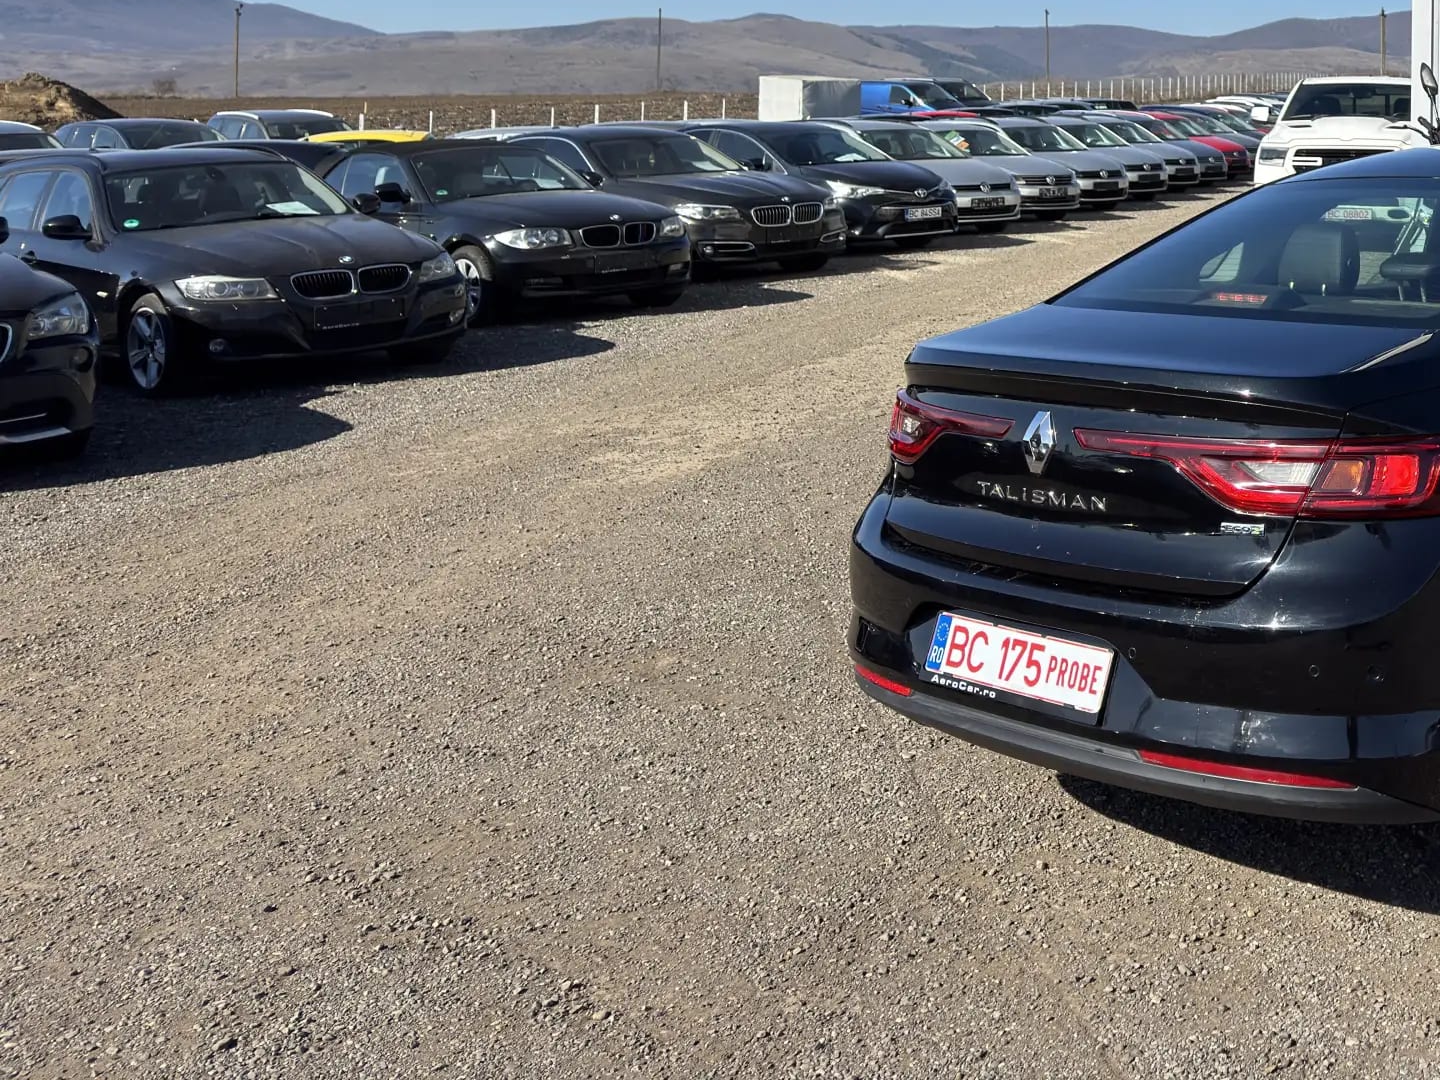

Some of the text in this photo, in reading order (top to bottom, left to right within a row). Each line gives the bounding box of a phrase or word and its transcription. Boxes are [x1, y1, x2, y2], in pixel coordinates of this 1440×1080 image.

[976, 480, 1107, 512] TALISMAN
[929, 644, 945, 664] RO
[945, 624, 1103, 695] BC 175 PROBE
[930, 674, 997, 699] AeroCar.ro
